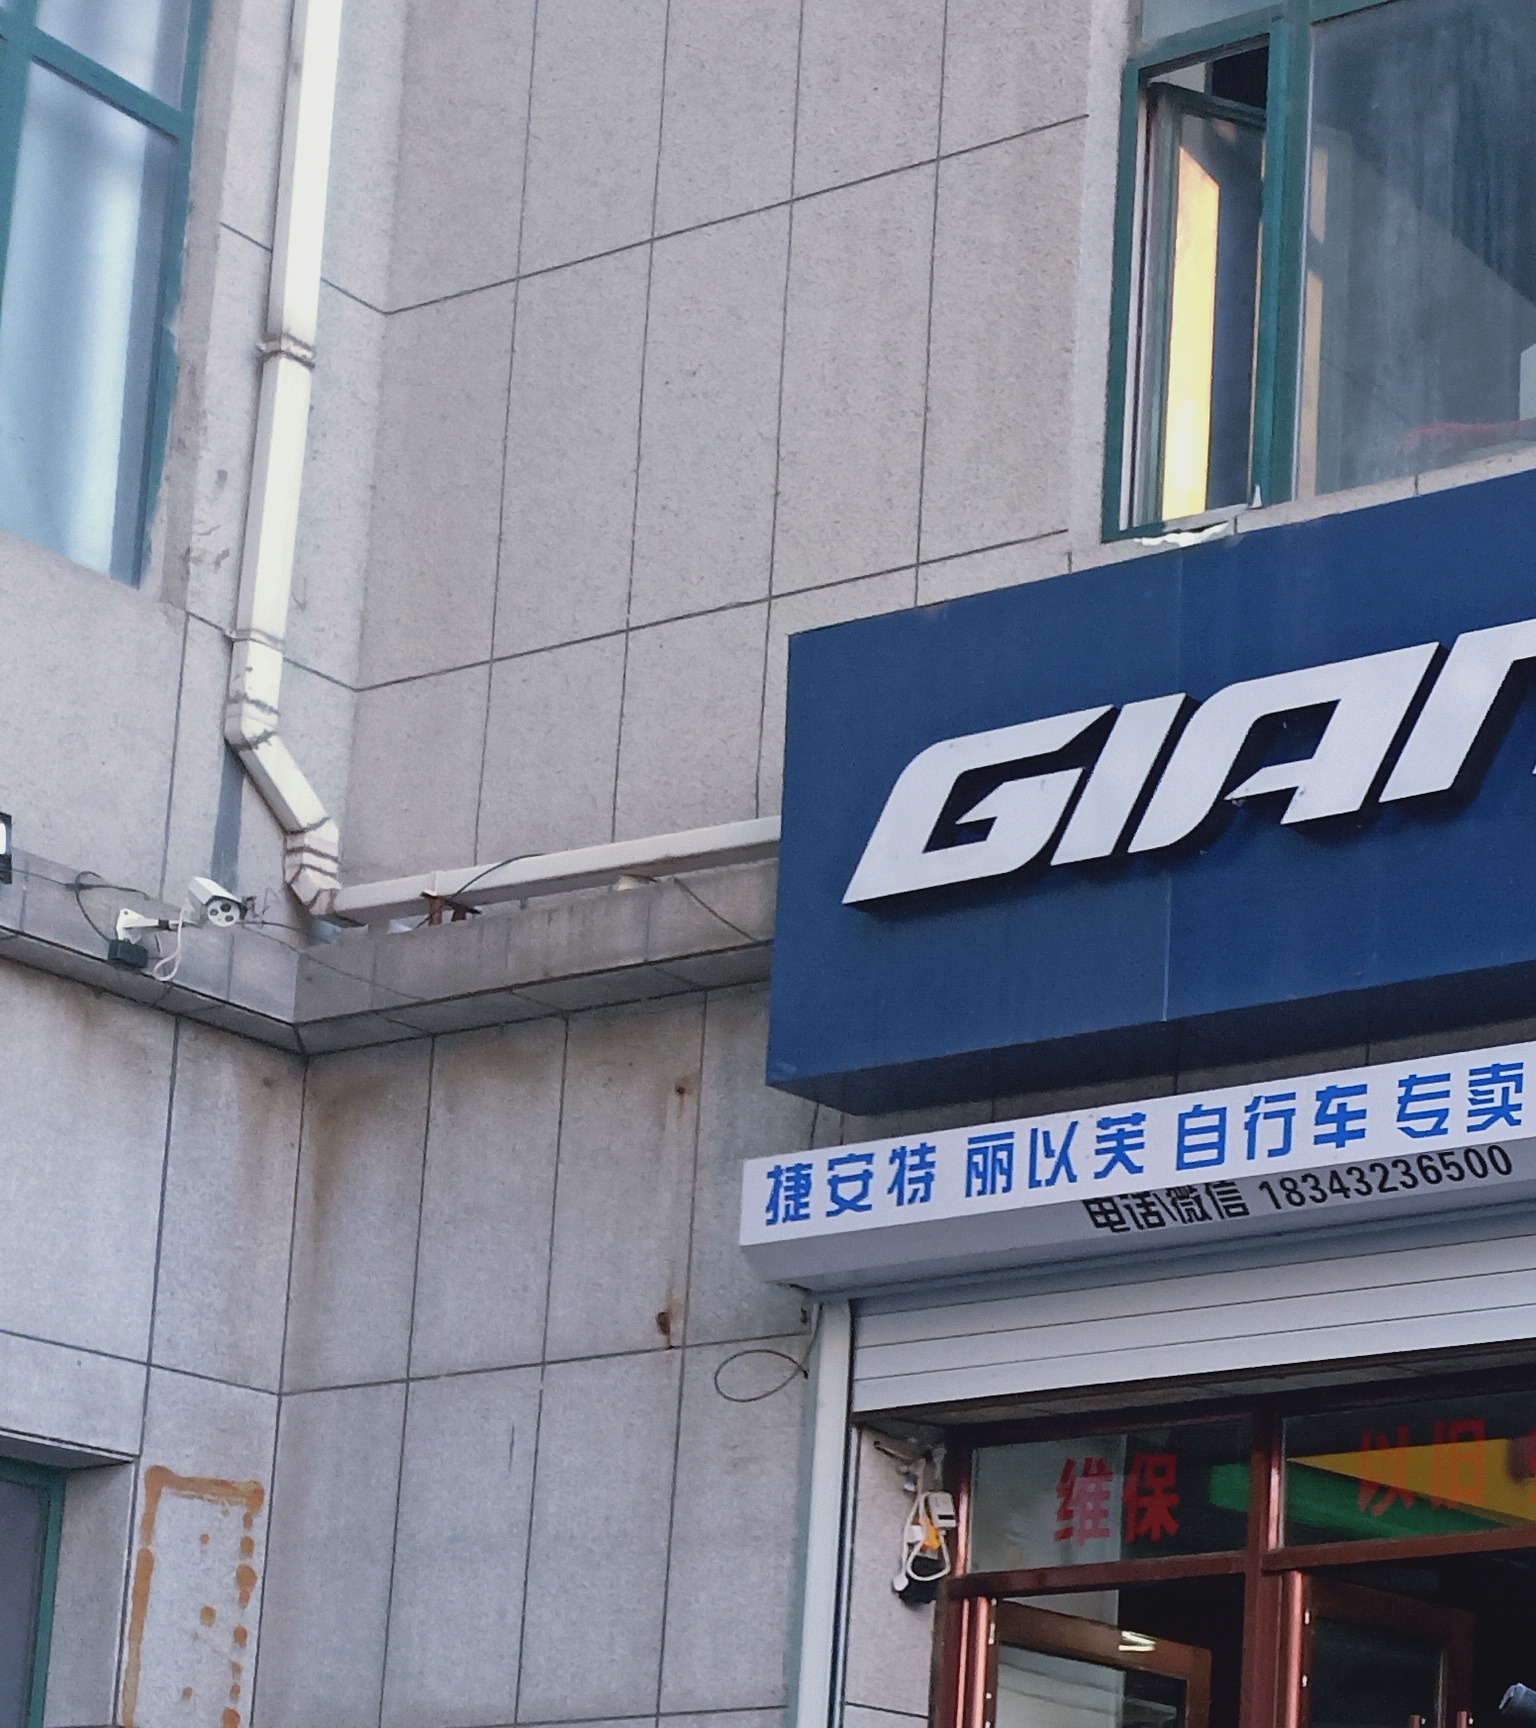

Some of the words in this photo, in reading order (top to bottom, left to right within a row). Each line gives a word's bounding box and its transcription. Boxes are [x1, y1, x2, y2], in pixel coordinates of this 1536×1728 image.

[765, 1141, 937, 1226] 捷安特
[965, 1111, 1147, 1198] 丽以芙
[1176, 1083, 1368, 1172] 自行车
[1258, 1143, 1514, 1211] 18343236500
[1053, 1451, 1180, 1547] 维保
